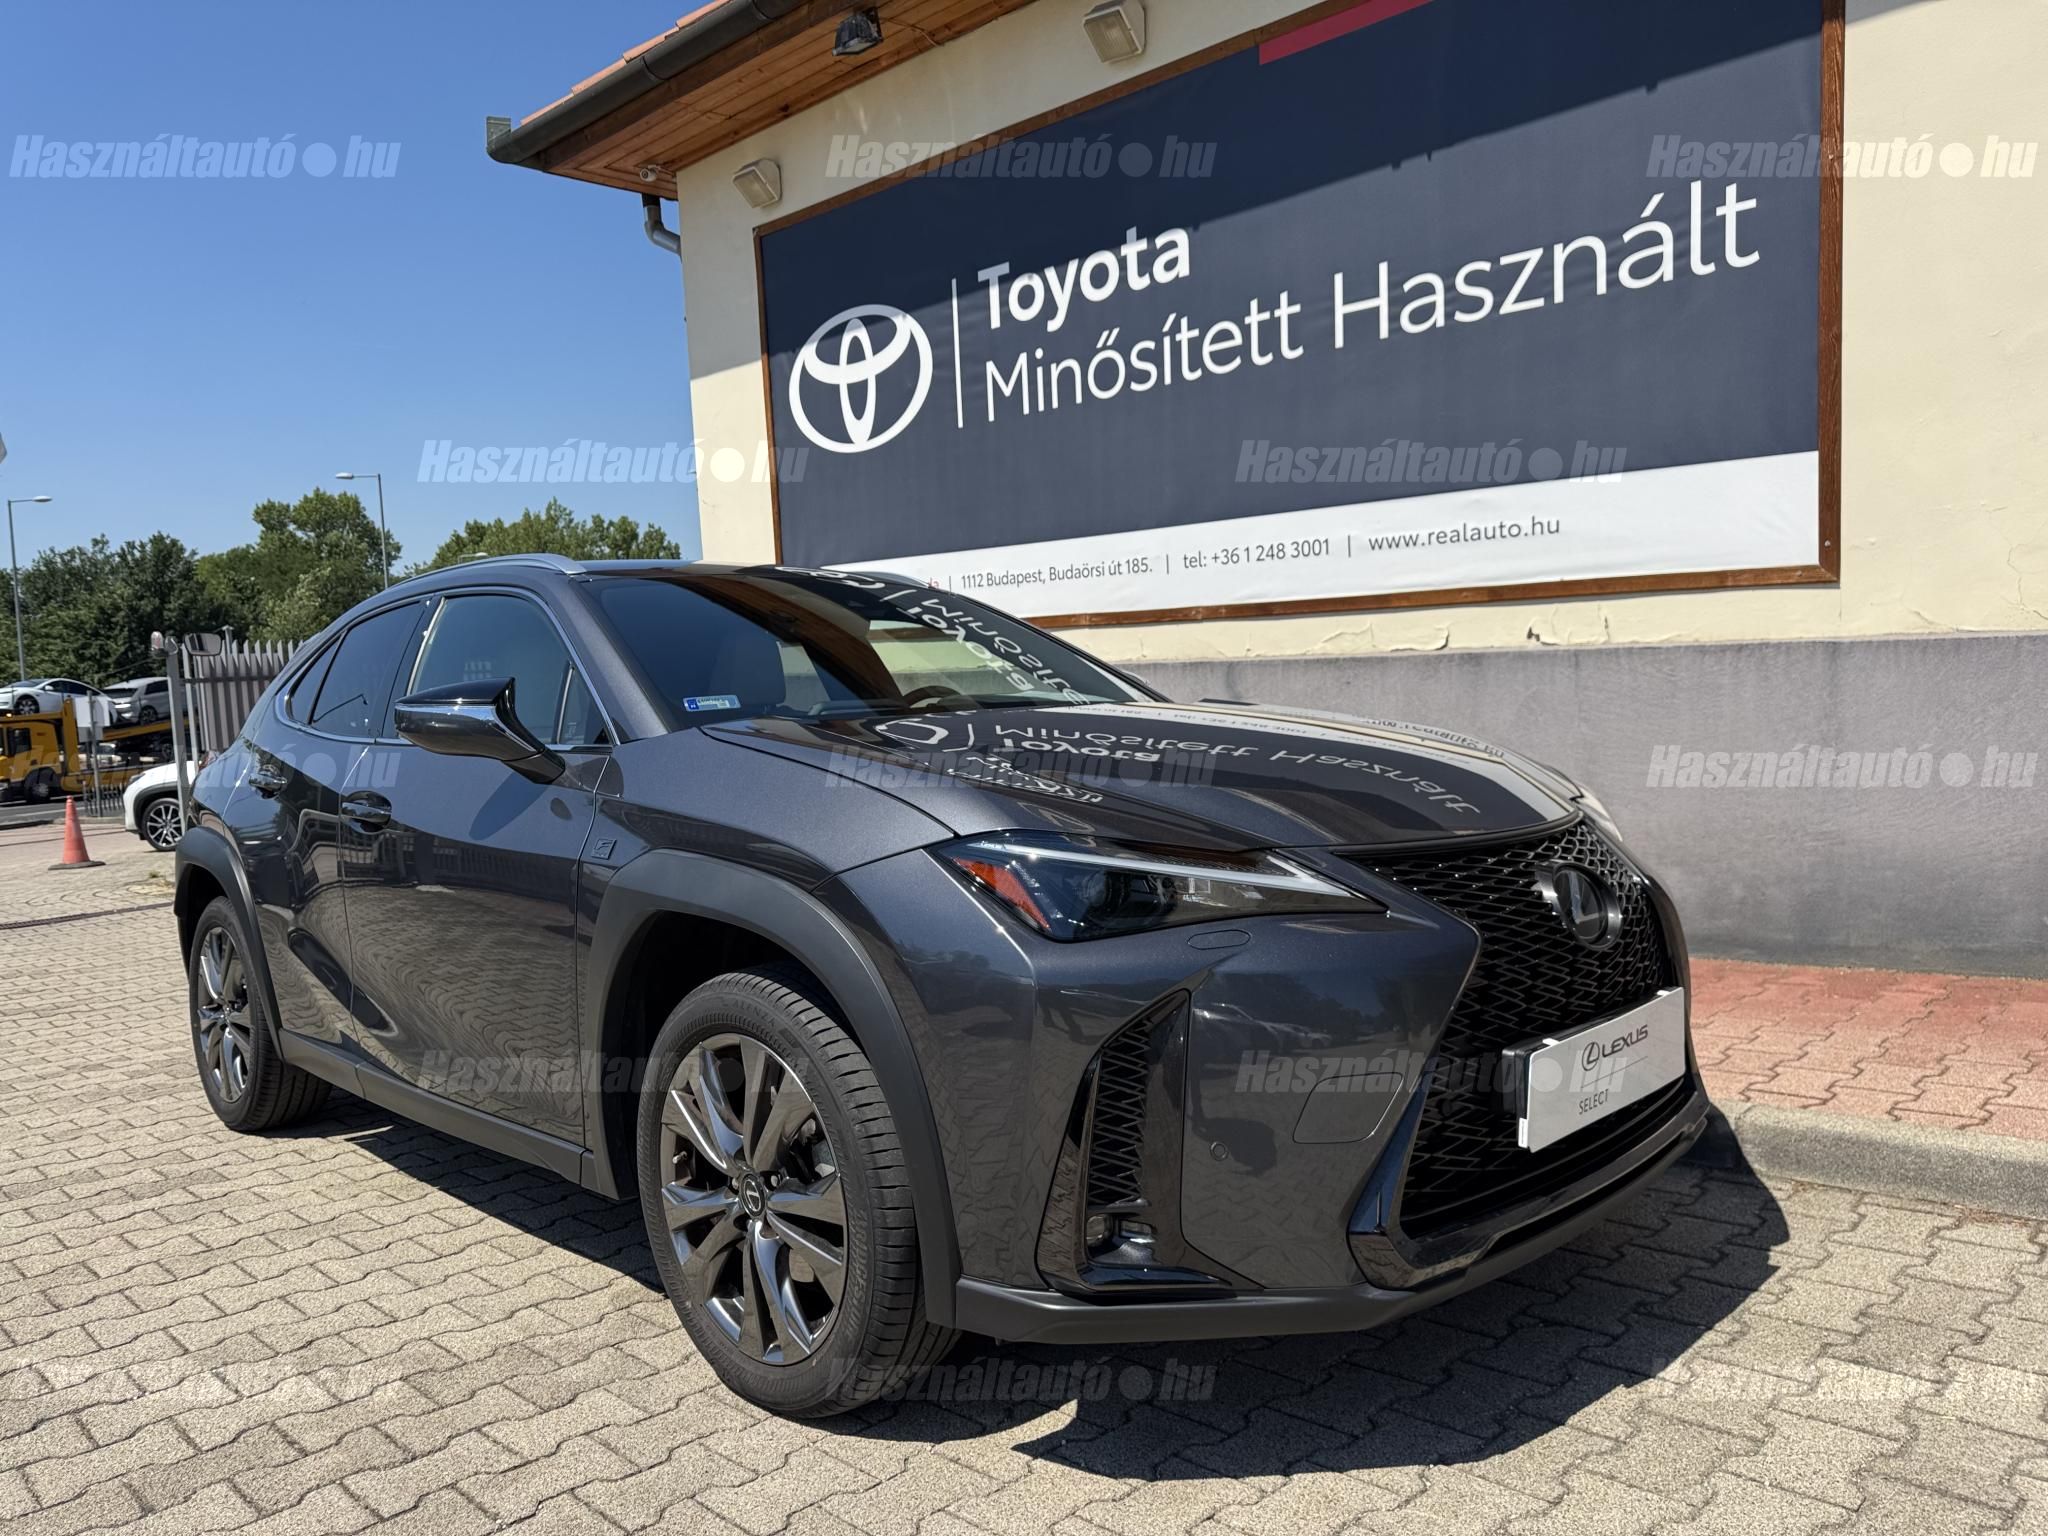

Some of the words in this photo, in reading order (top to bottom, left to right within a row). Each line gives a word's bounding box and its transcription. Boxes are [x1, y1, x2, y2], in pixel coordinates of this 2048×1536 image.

[978, 226, 1191, 333] Toyota
[985, 290, 1304, 422] Minősített
[1332, 179, 1761, 349] Használt
[962, 574, 985, 589] 1112
[986, 568, 1046, 588] Budapest,
[1048, 562, 1105, 582] Budaörsi
[1108, 560, 1123, 577] út
[1125, 557, 1152, 575] 185.
[1183, 551, 1207, 569] tel:
[1211, 546, 1240, 566] +36
[1255, 542, 1286, 563] 248
[1291, 538, 1330, 559] 3001
[1368, 515, 1561, 552] www.realauto.hu
[1602, 1024, 1648, 1058] LEXUS
[1578, 1088, 1609, 1115] SELECT
